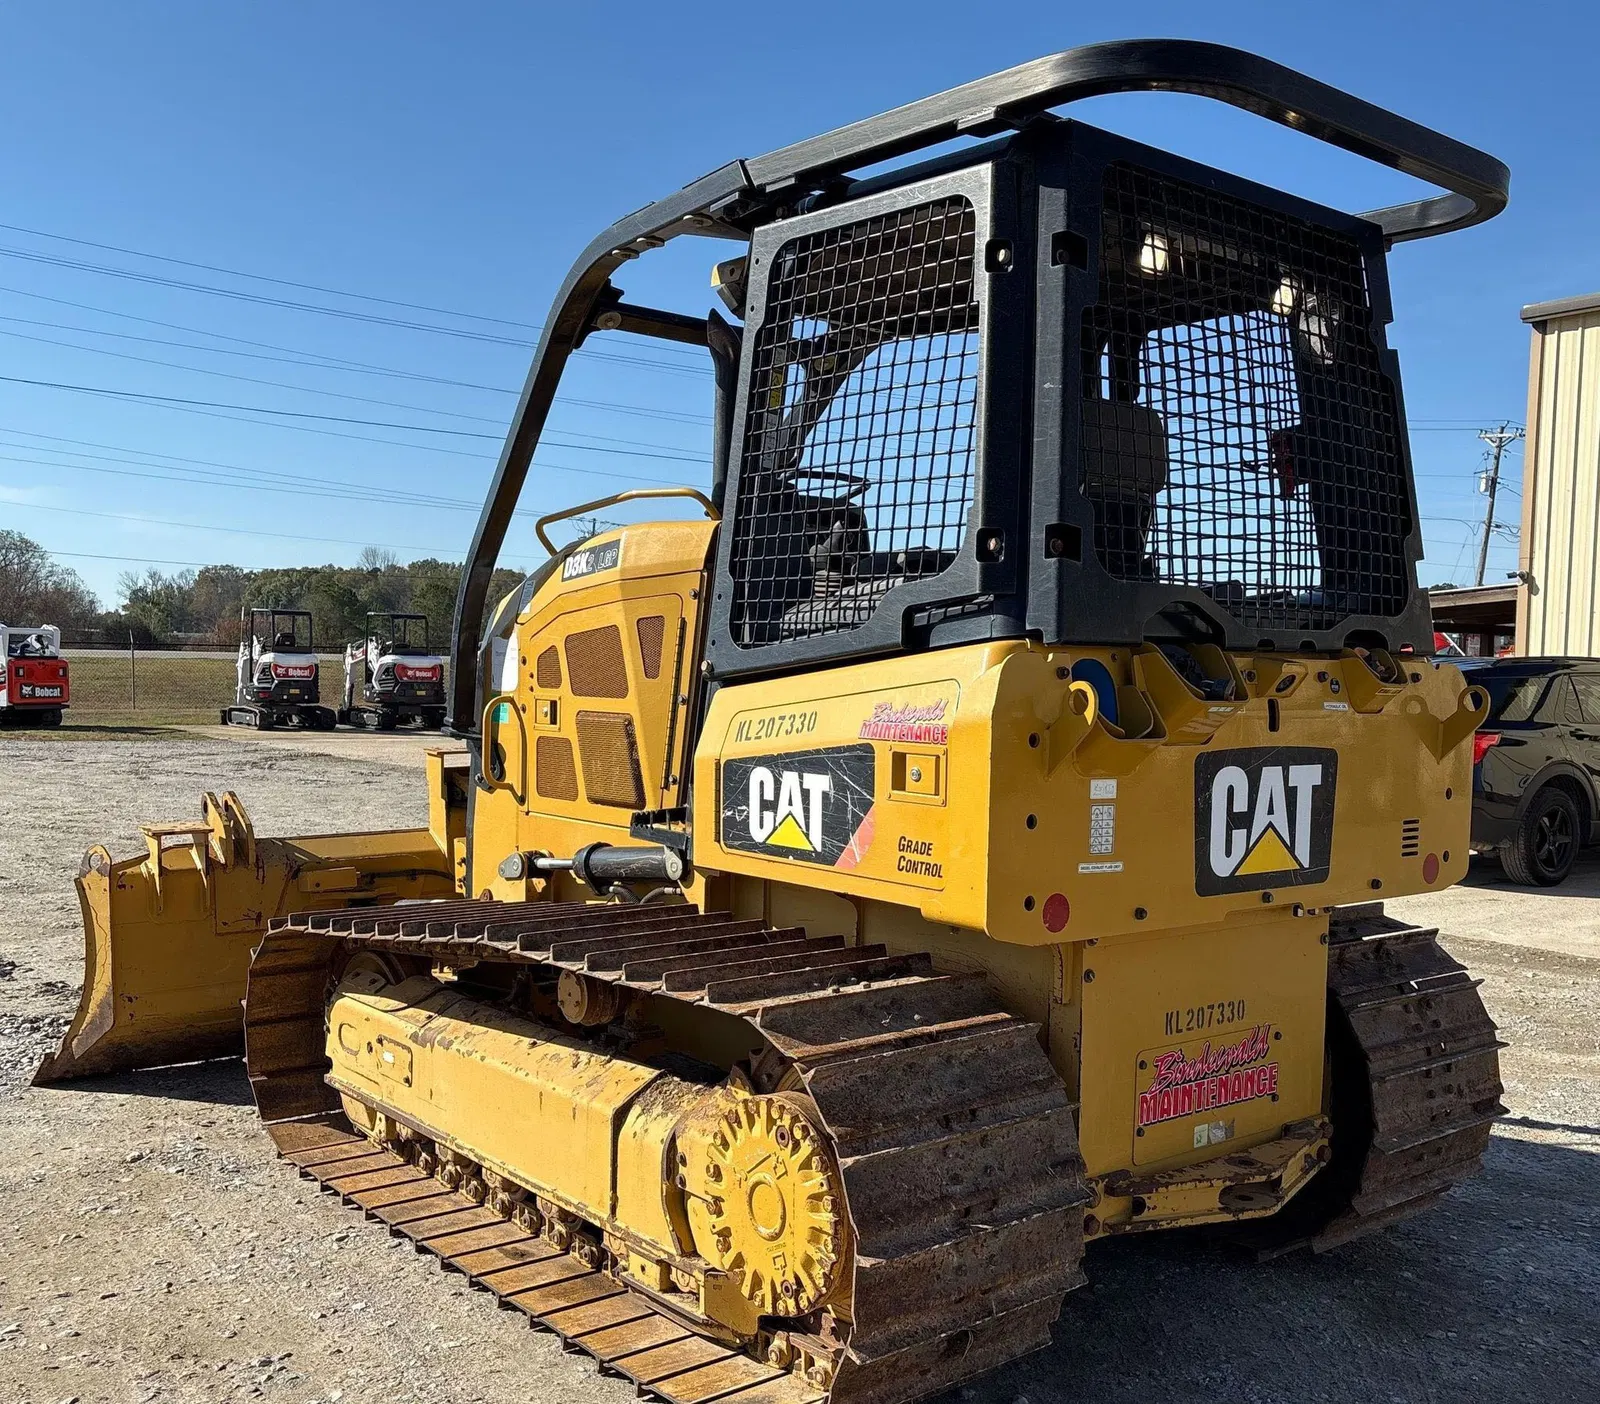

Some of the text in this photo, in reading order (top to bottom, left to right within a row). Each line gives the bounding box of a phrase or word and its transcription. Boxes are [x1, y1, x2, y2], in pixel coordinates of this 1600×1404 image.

[288, 667, 311, 677] Bobcat
[35, 686, 61, 697] Bobcat
[735, 711, 818, 743] KL207330
[858, 721, 948, 745] MAINTENANCE
[748, 766, 830, 852] CAT
[1209, 763, 1322, 878] CAT
[898, 836, 933, 857] GRADE
[897, 856, 943, 879] CONTROL
[1165, 999, 1245, 1036] KL207330
[1139, 1063, 1279, 1125] MAINTENANCE
